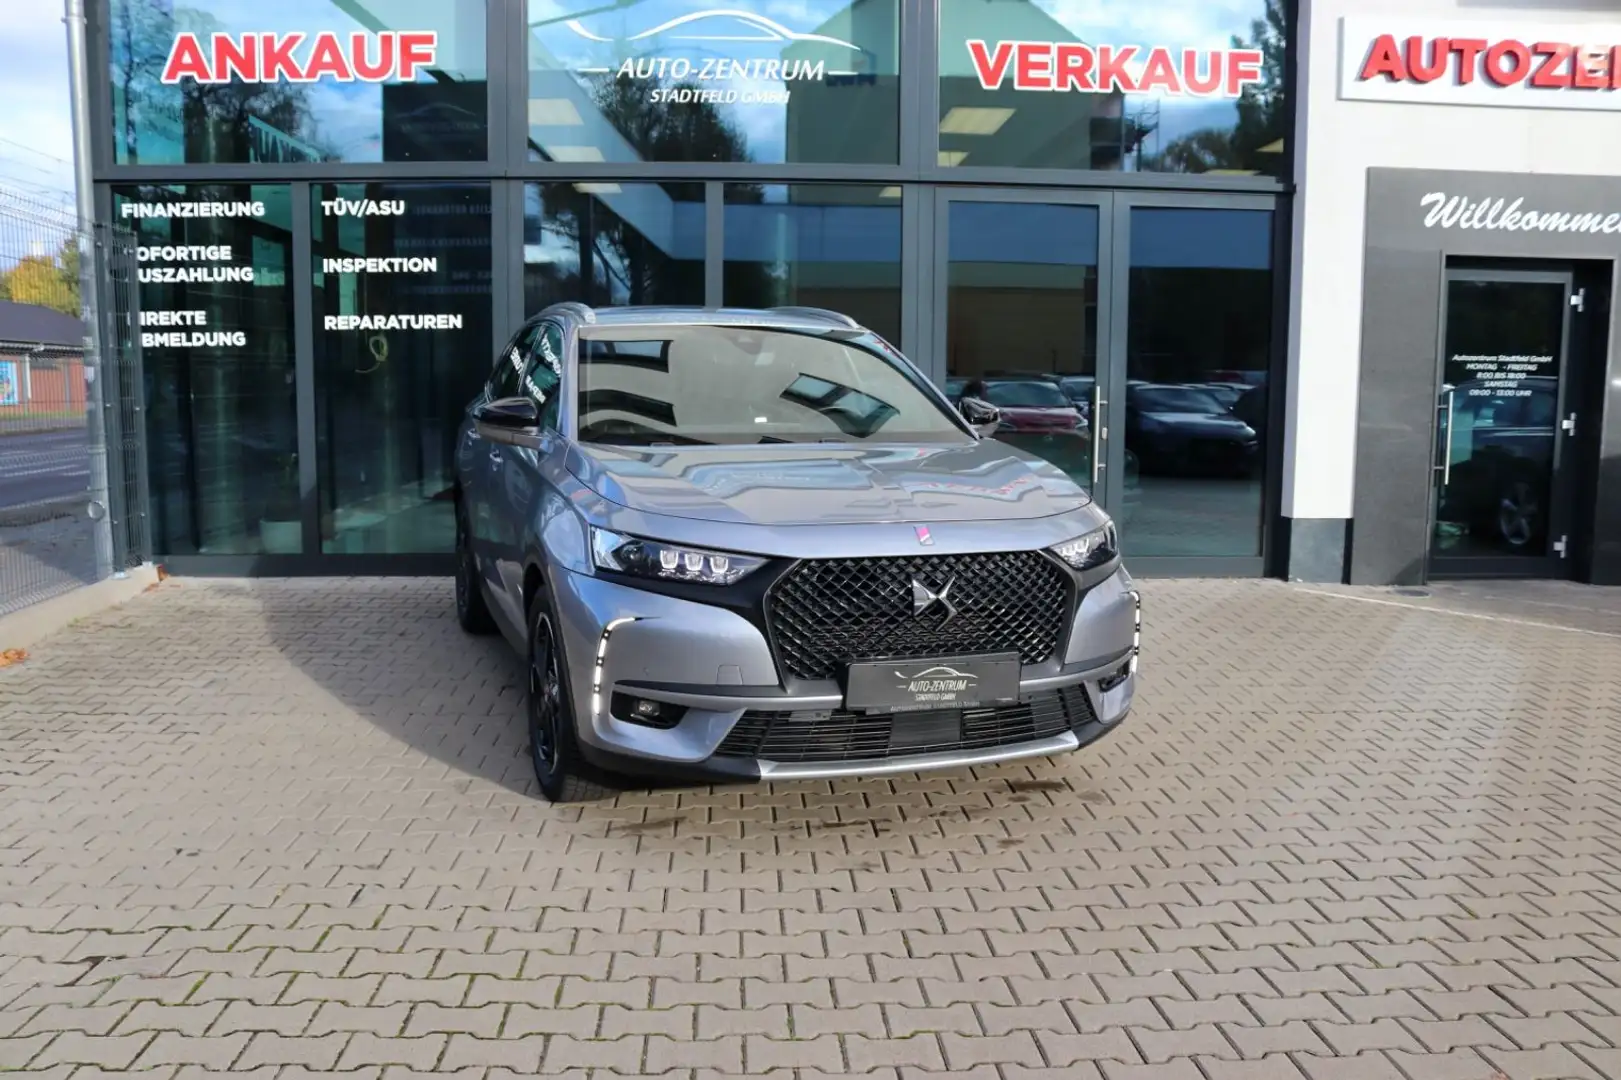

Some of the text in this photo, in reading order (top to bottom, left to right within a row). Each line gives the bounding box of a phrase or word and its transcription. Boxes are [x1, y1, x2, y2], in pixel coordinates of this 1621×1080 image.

[161, 30, 438, 85] ANKAUF
[616, 57, 825, 82] AUTO-ZENTRUM
[967, 39, 1264, 98] VERKAUF
[650, 88, 737, 104] STADTFELD
[121, 202, 266, 218] FINANZIERUNG
[321, 198, 406, 216] TÜV/ASU
[124, 245, 233, 262] OFORTIGE
[322, 257, 438, 273] INSPEKTION
[126, 266, 255, 283] USZAHLUNG
[127, 310, 208, 326] IREKTE
[324, 314, 463, 330] REPARATUREN
[127, 331, 247, 347] BMELDUNG
[907, 679, 967, 692] AUTO-ZENTRUM
